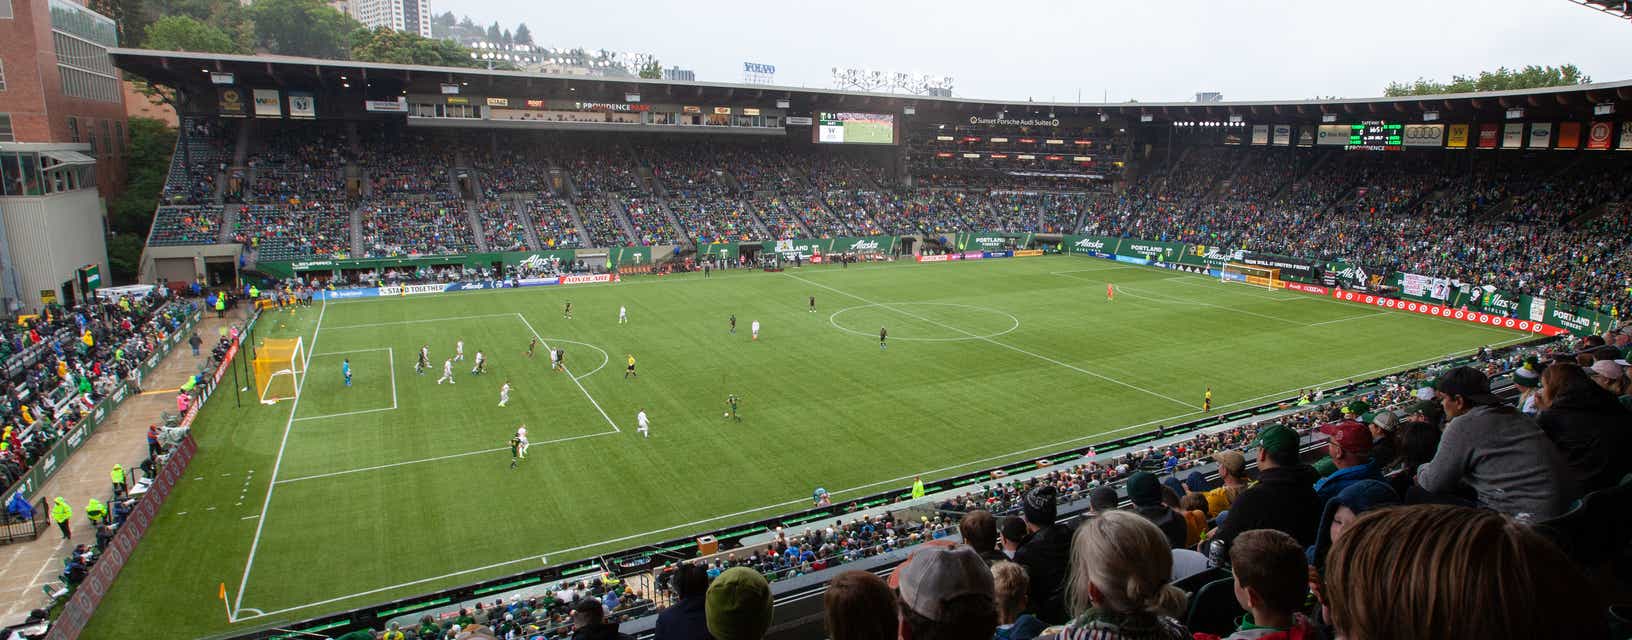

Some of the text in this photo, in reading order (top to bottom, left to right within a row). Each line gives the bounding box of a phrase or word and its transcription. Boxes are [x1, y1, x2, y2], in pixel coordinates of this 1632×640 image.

[744, 62, 775, 74] VOLVO
[583, 102, 631, 111] PROVIDENCE
[977, 117, 997, 125] Sunset
[997, 118, 1020, 126] Porsche
[850, 239, 879, 250] Alaska
[1074, 238, 1104, 249] Alaska
[1131, 244, 1162, 253] PORTLAND
[387, 284, 443, 295] STAD TOGETHER
[1553, 309, 1590, 327] PORTLAND
